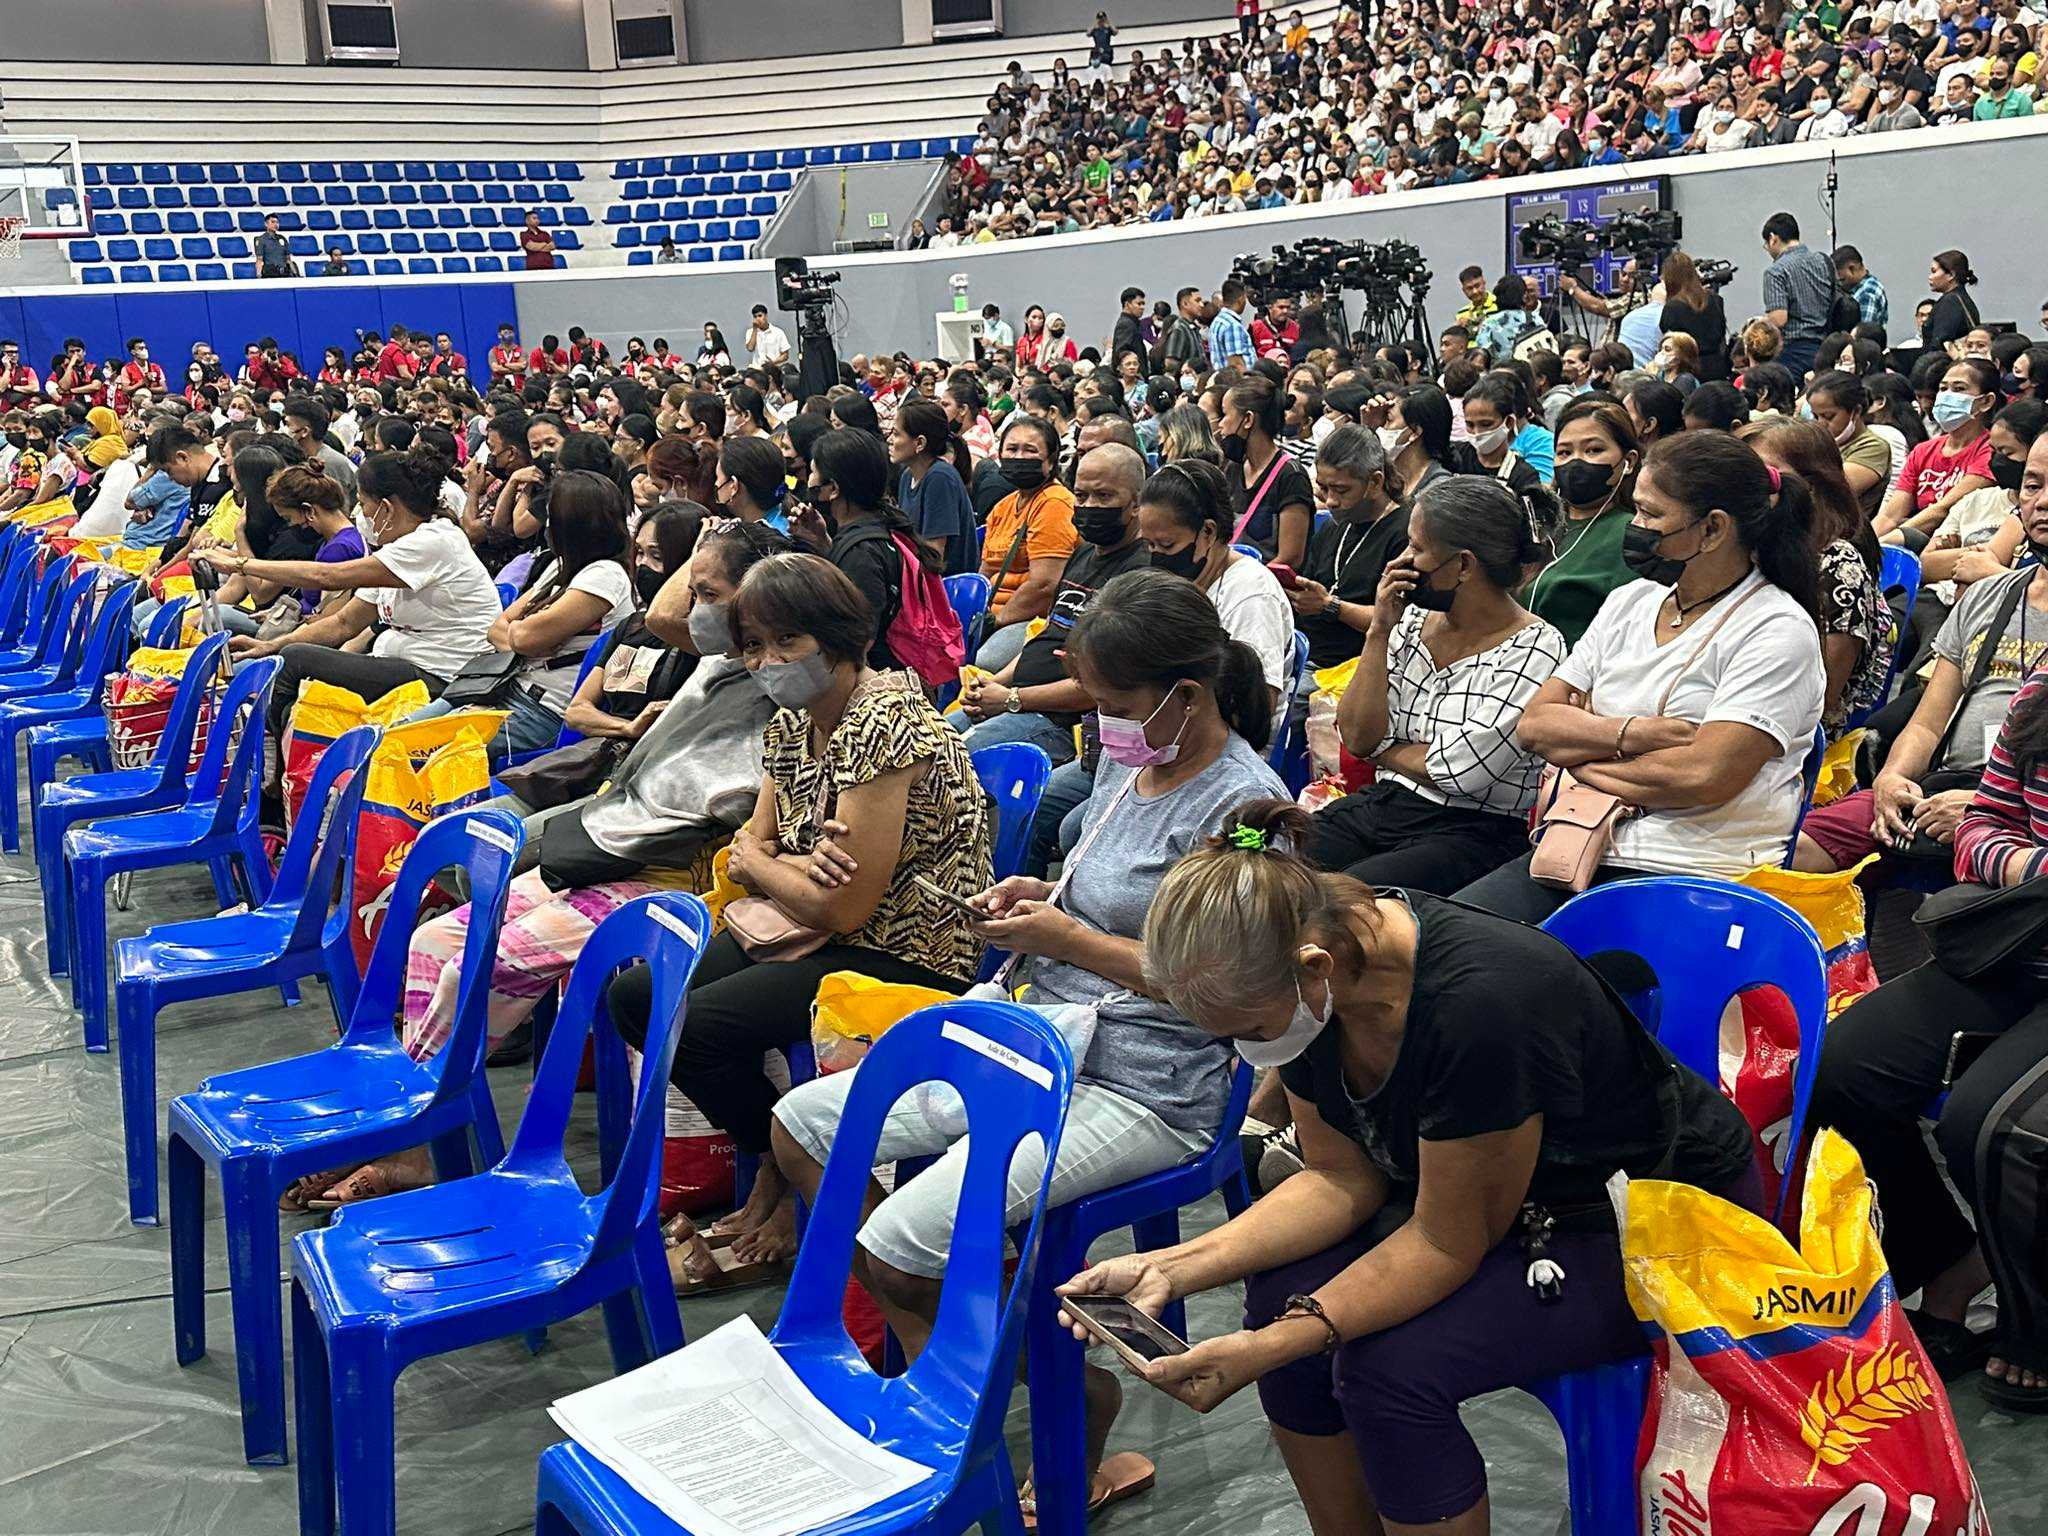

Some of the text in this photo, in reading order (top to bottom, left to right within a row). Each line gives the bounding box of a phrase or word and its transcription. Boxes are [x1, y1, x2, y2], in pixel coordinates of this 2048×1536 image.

[1606, 182, 1650, 195] TEAM NAME
[1520, 193, 1561, 205] TEAM NAME
[1577, 199, 1589, 214] VS
